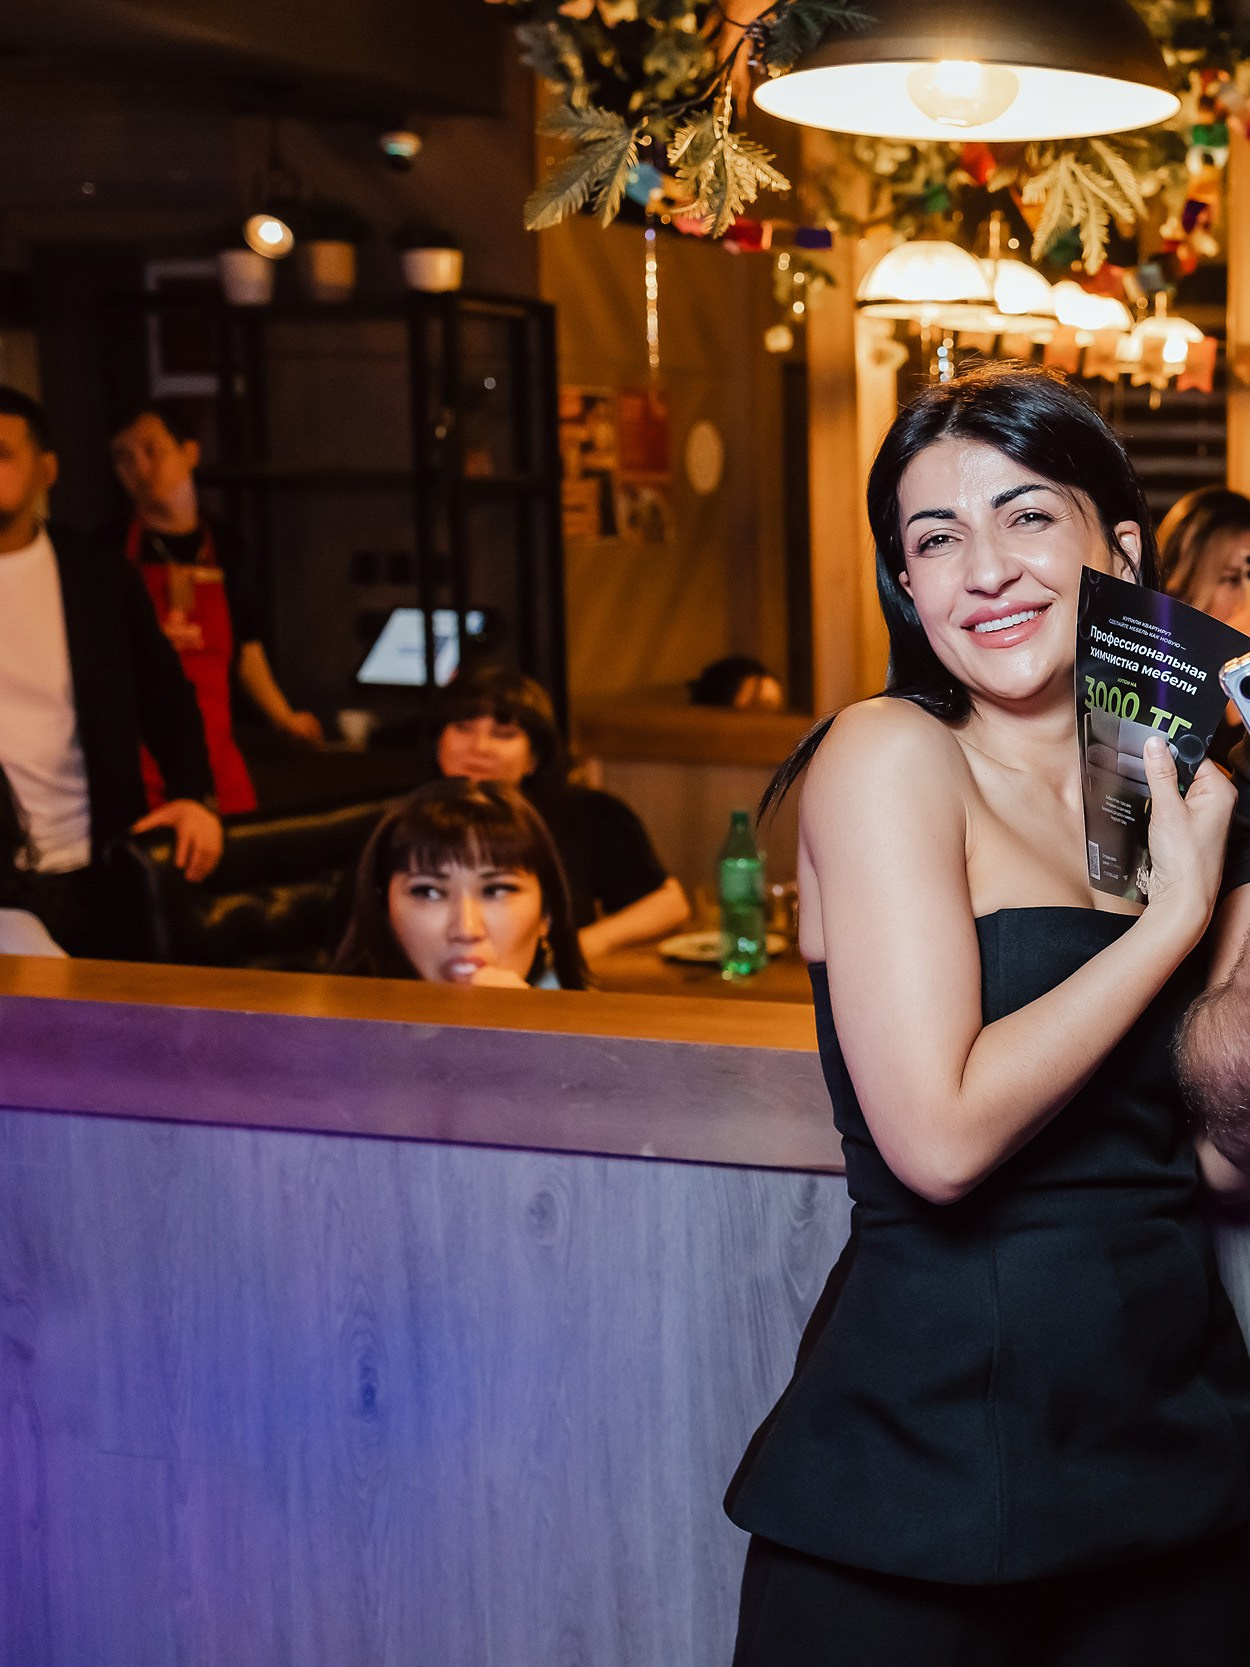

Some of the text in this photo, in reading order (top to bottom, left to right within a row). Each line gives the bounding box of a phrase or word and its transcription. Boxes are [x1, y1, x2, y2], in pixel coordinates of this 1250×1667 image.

[1090, 625, 1208, 682] Профессиональная
[1129, 625, 1149, 636] МЕБЕЛЬ
[1148, 632, 1160, 640] КАК
[1160, 636, 1181, 648] НОВУЮ
[1089, 646, 1198, 696] химчистка мебели
[1084, 675, 1140, 722] 3000
